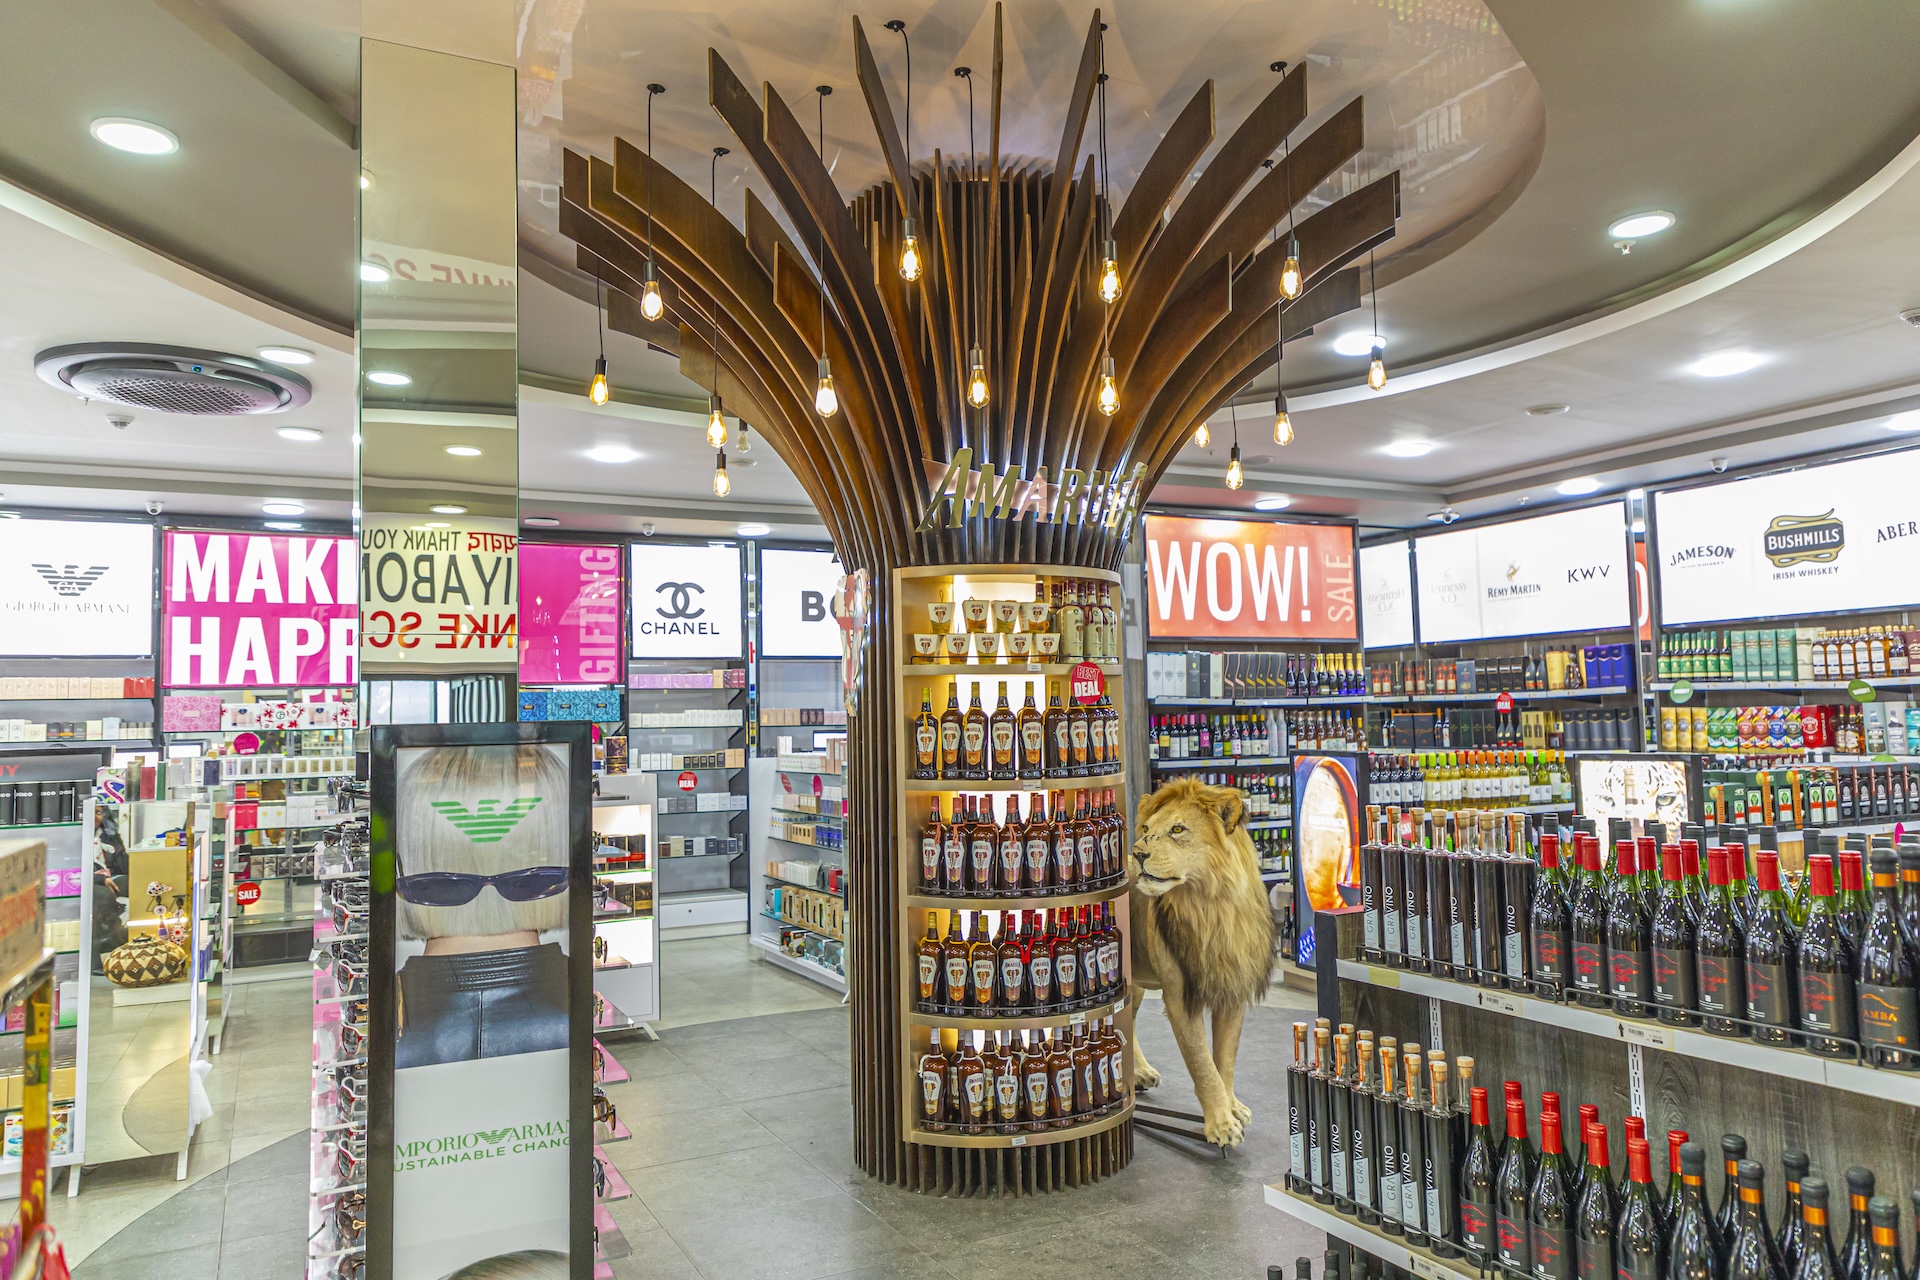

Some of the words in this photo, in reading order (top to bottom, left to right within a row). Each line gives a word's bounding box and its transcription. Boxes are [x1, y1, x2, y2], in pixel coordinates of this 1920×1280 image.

[914, 447, 1149, 544] AMARULA
[1768, 528, 1840, 551] BUSHMILLS
[1877, 521, 1918, 543] ABER
[1670, 545, 1735, 566] JAMESON
[1148, 539, 1312, 622] WOW!
[1568, 564, 1610, 583] KWV
[1773, 570, 1796, 580] IRISH
[1798, 566, 1839, 577] WHISKEY
[1325, 554, 1354, 623] SALE
[1510, 583, 1541, 596] MARTIN
[6, 601, 68, 612] GIORGIO
[76, 602, 130, 614] ARMANI
[578, 548, 616, 682] GIFTING
[641, 621, 720, 635] CHANEL
[1077, 665, 1100, 680] BEST
[1074, 681, 1100, 697] DEAL
[679, 780, 695, 788] DEAL
[239, 889, 259, 900] SALE
